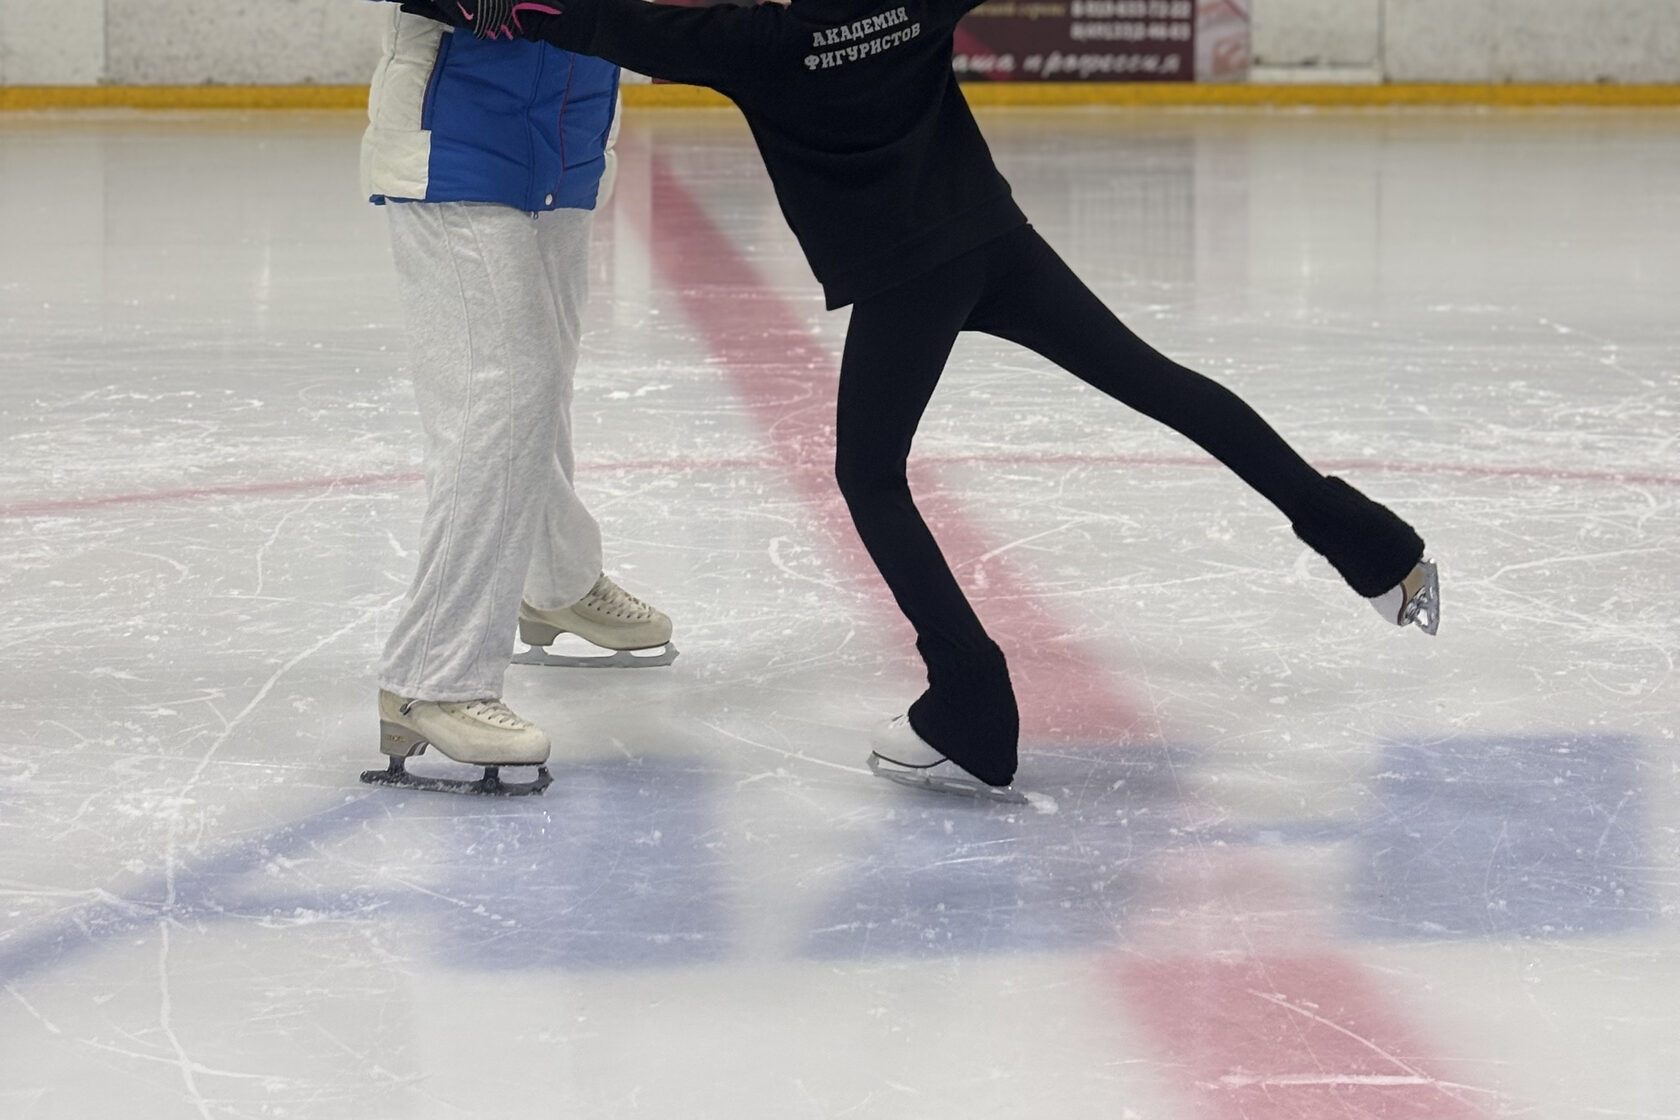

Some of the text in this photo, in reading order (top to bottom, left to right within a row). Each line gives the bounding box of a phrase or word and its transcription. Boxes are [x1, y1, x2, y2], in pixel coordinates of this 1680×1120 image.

[804, 22, 921, 70] ФИГУРИСТОВ
[812, 6, 909, 48] АКАДЕМИЯ
[952, 54, 1015, 72] аша
